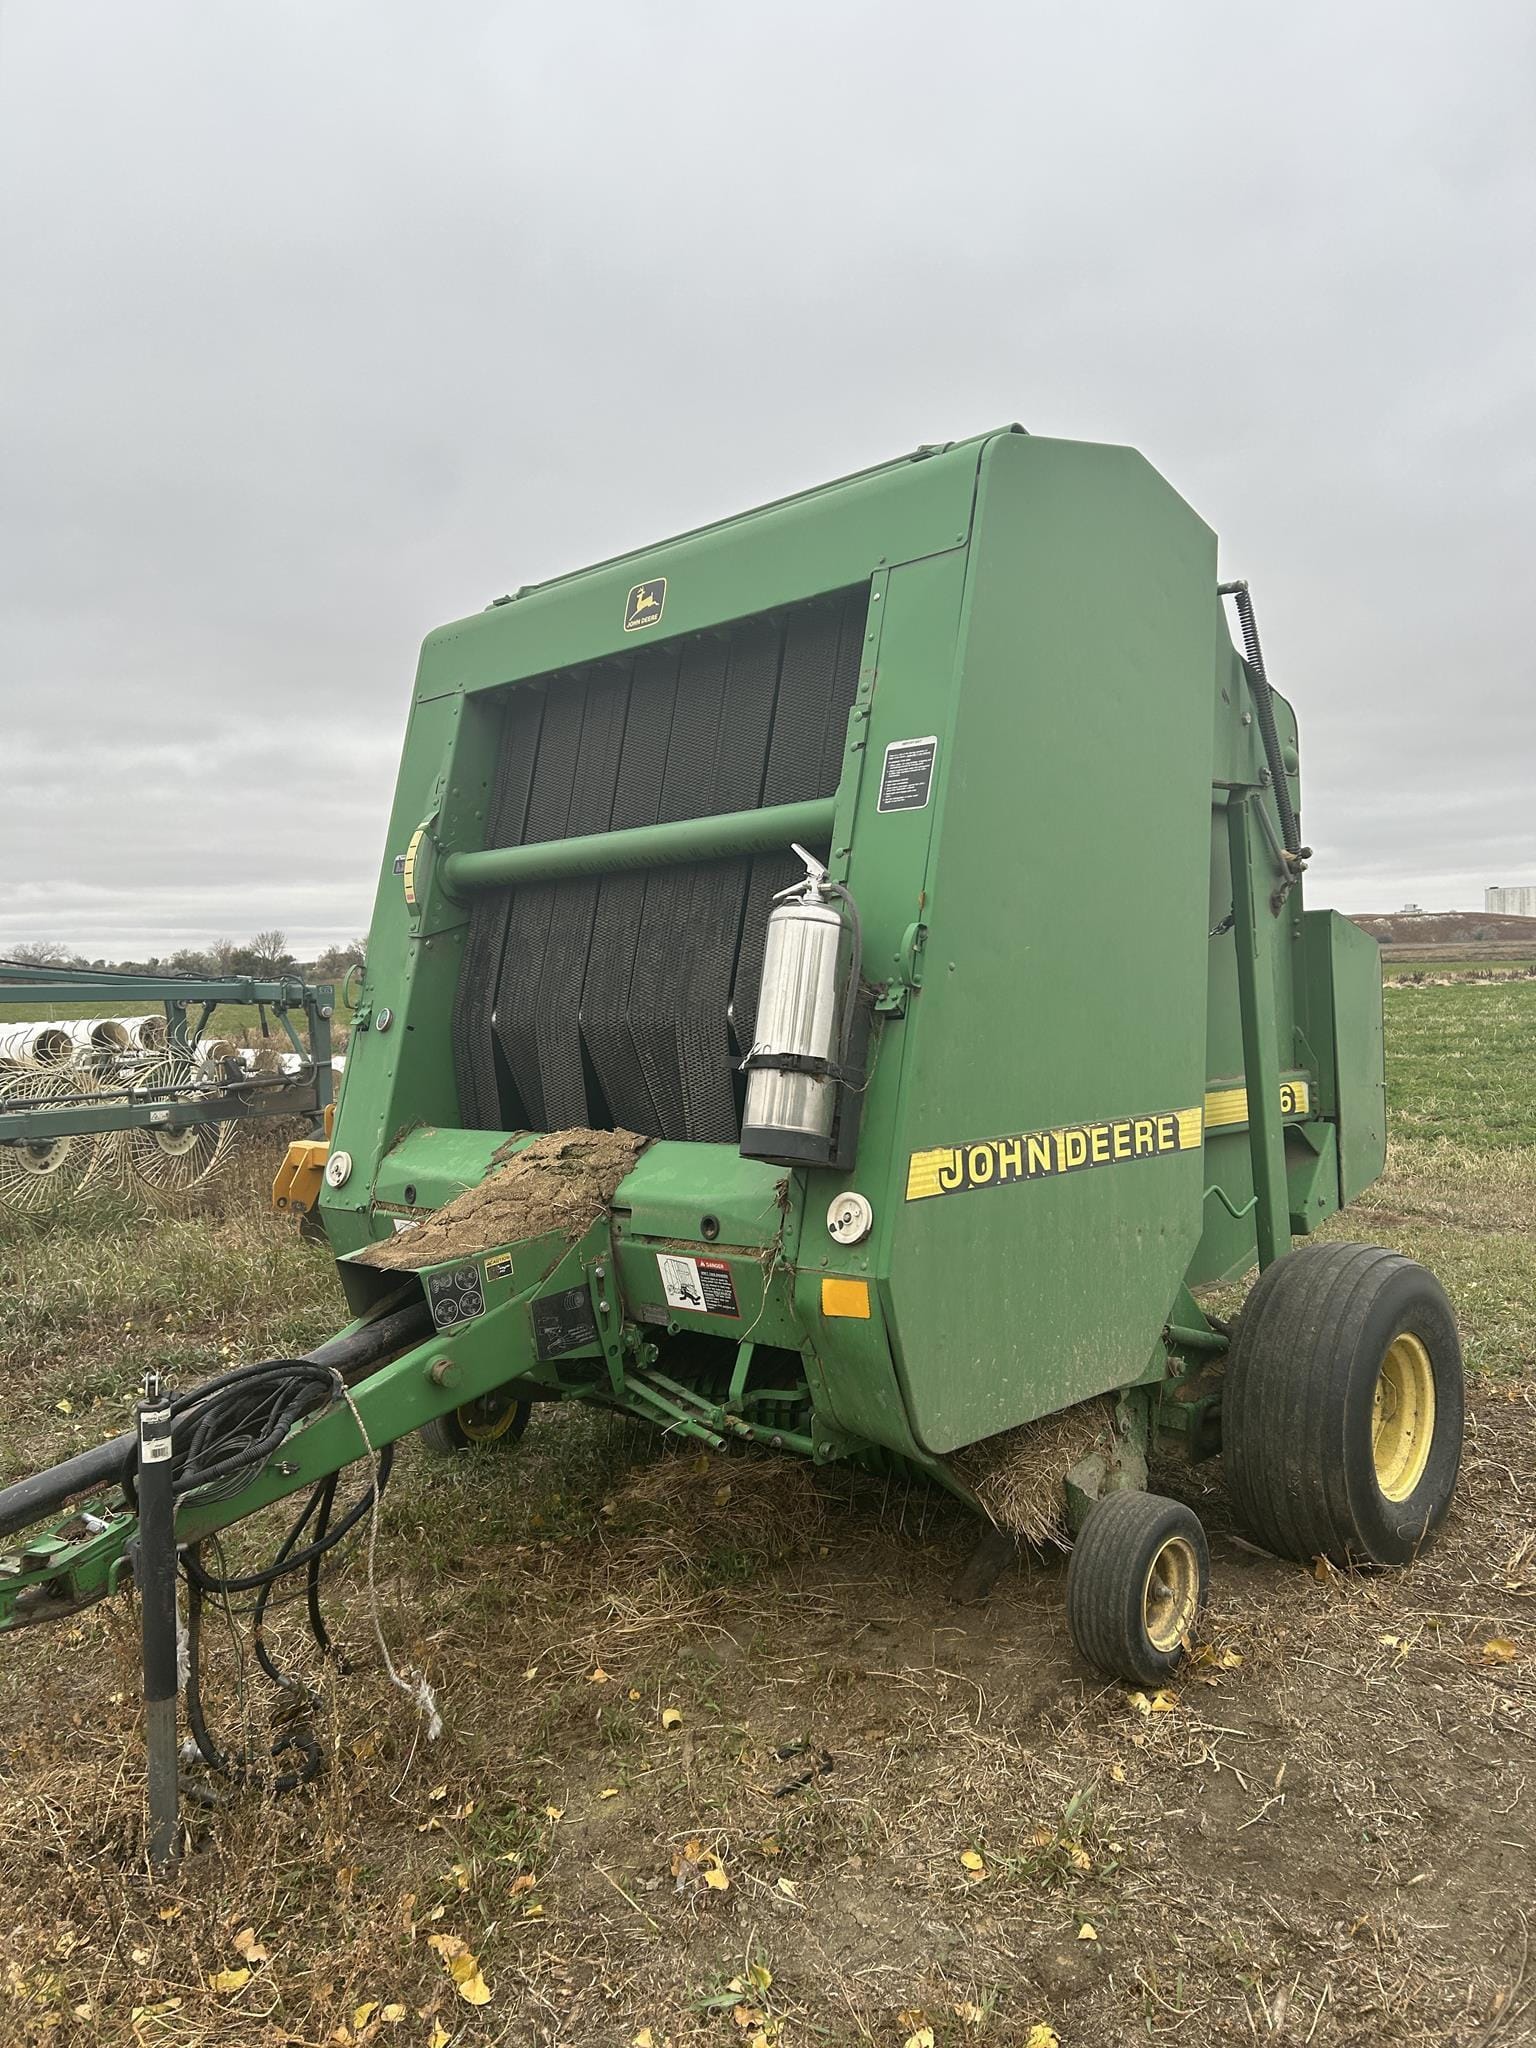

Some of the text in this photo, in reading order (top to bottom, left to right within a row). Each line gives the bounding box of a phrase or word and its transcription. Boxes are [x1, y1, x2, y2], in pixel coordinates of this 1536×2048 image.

[627, 614, 658, 628] JOHN DEERE
[940, 1115, 1175, 1190] JOHN DEERE
